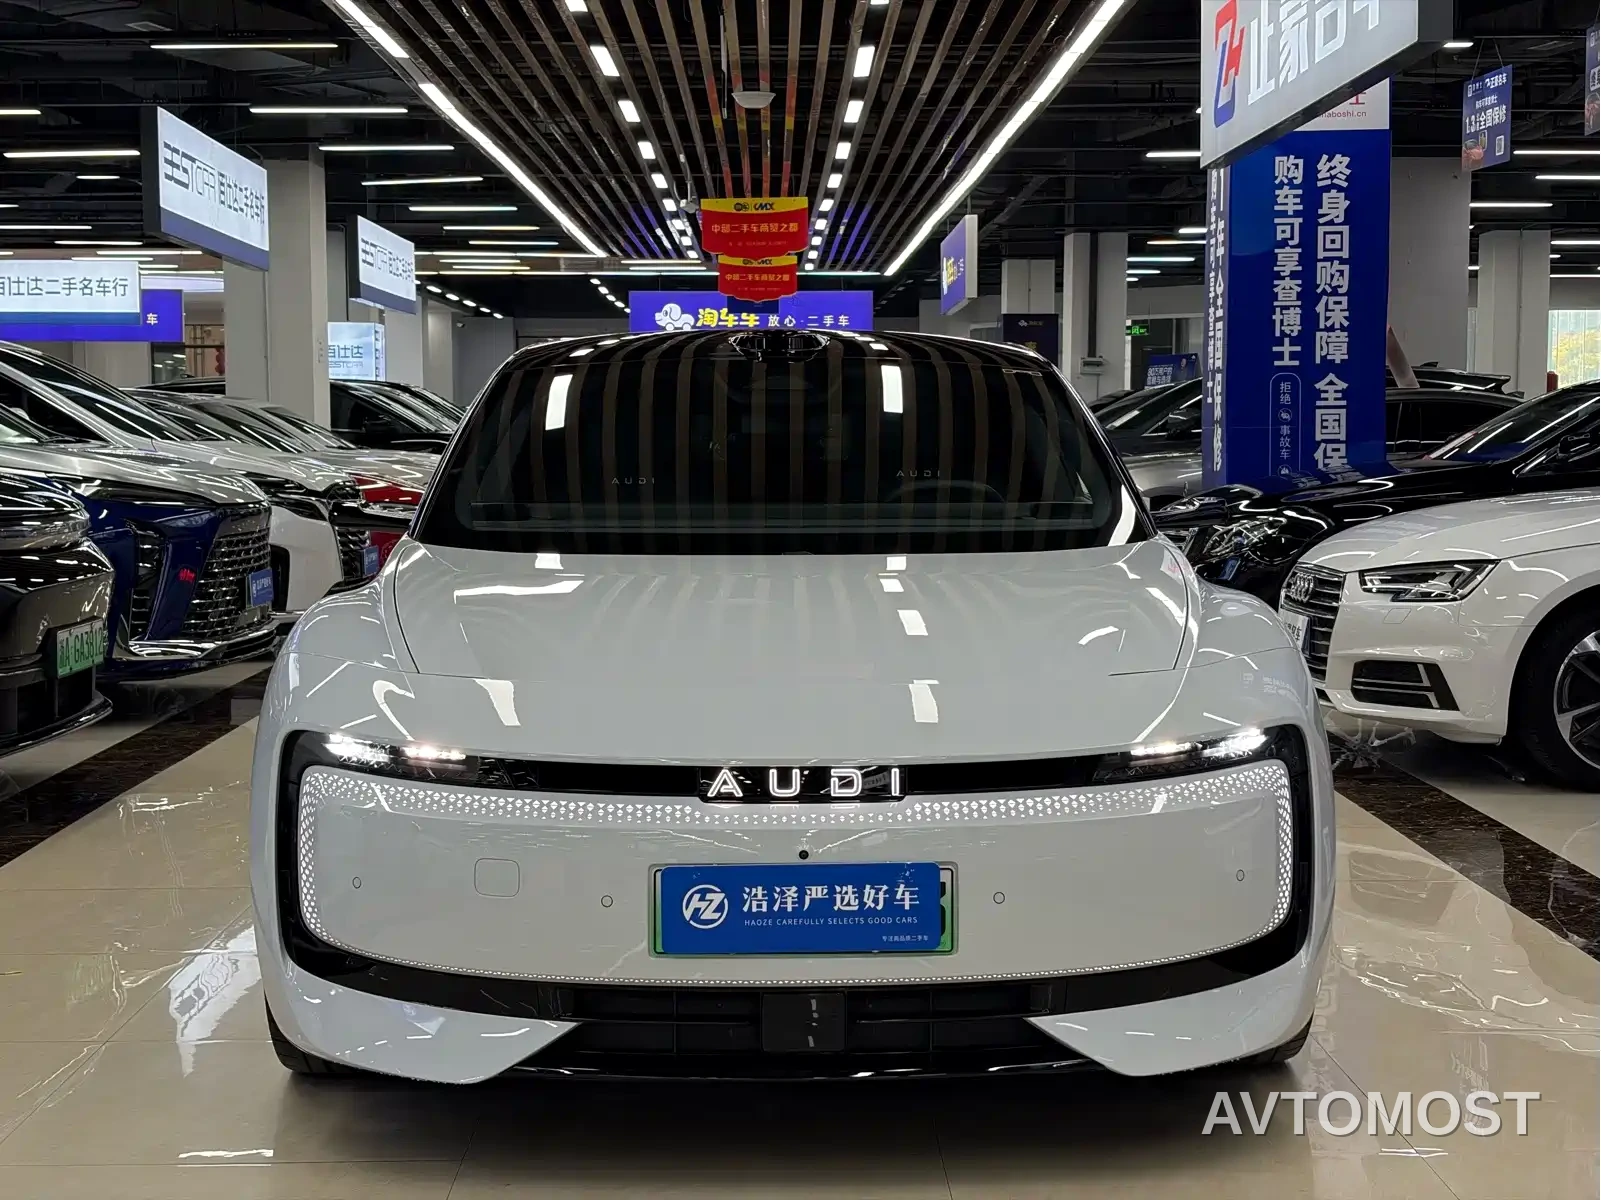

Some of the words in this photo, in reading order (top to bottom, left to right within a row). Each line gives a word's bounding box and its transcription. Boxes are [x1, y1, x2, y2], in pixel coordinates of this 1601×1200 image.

[1272, 154, 1304, 367] 购车可享查博士
[1316, 153, 1352, 364] 终身回购保障
[146, 312, 158, 326] 车
[1279, 381, 1292, 405] 拒绝
[1279, 424, 1292, 461] 事故车
[611, 477, 656, 485] AUDI
[896, 469, 941, 478] AUDI
[706, 767, 901, 798] AUDI
[742, 883, 921, 913] 浩泽严选好车
[744, 918, 774, 927] HAOZE
[776, 917, 825, 926] CAREFULLY
[827, 917, 865, 925] SELECTS
[868, 916, 893, 925] GOOD
[896, 915, 918, 925] CARS
